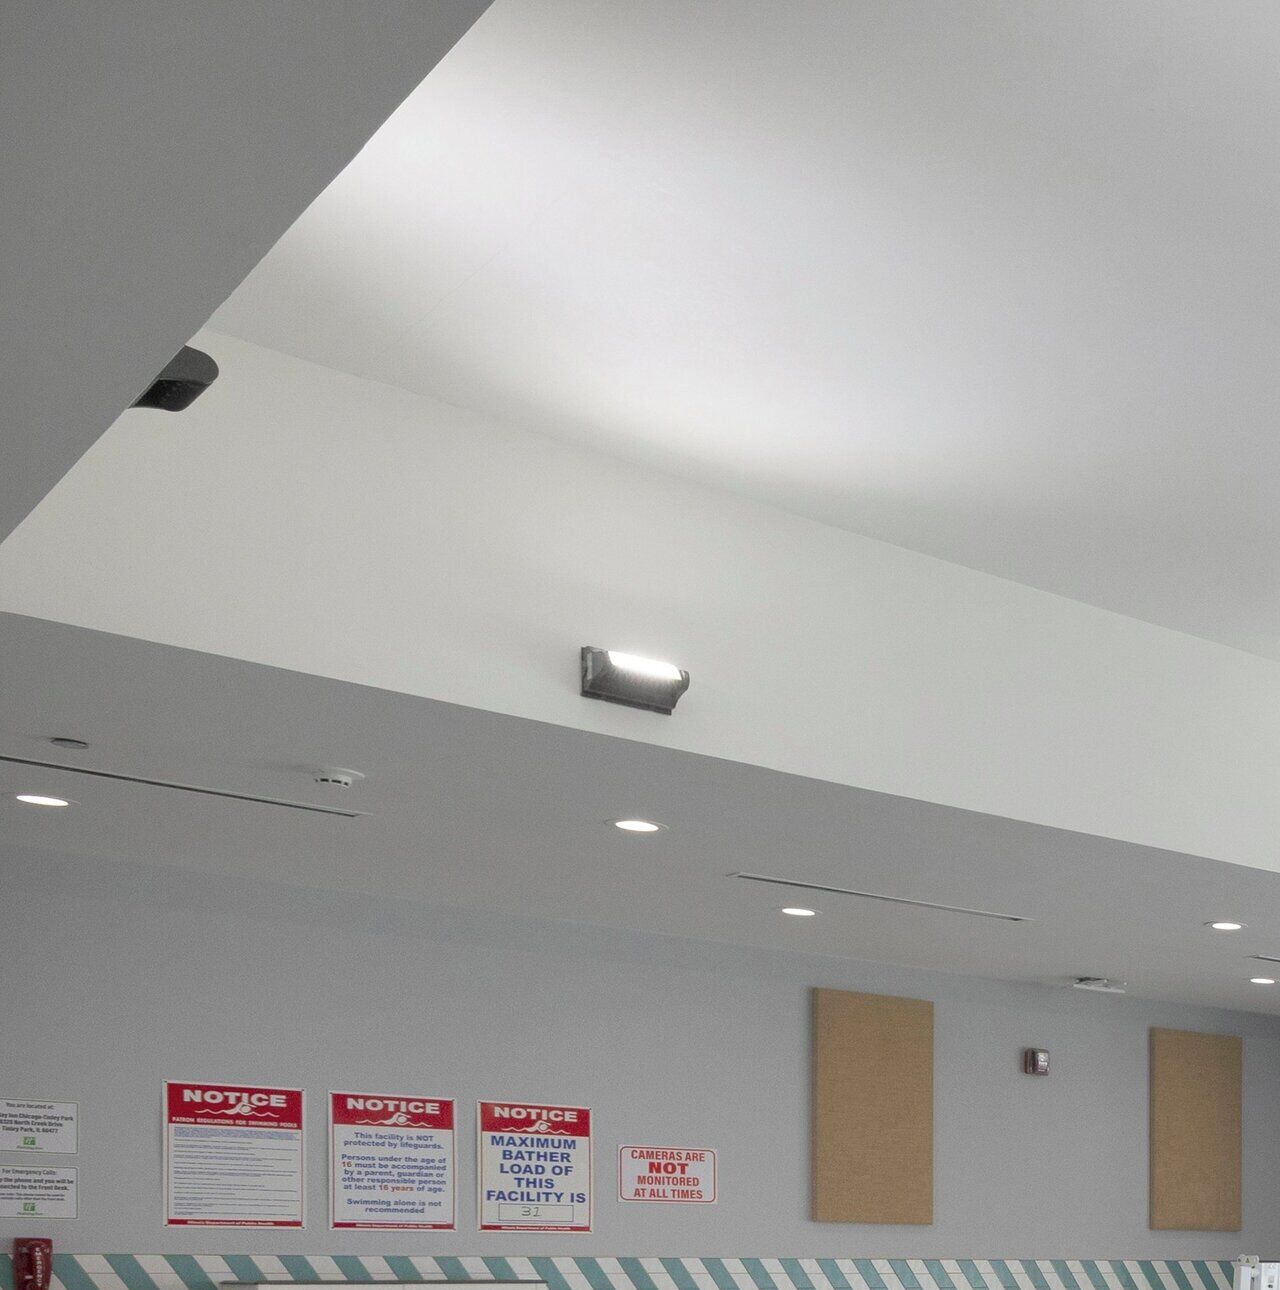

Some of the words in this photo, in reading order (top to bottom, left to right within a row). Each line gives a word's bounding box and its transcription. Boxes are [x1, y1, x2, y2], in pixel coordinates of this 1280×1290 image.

[183, 1089, 287, 1107] NOTICE
[347, 1098, 440, 1114] NOTICE
[494, 1106, 578, 1122] NOTICE
[375, 1133, 403, 1141] facility
[491, 1135, 576, 1149] MAXIMUM
[388, 1141, 397, 1149] by
[502, 1150, 571, 1162] BATHER
[631, 1149, 682, 1161] CAMERAS
[685, 1152, 705, 1162] ARE
[391, 1163, 446, 1171] accompanied
[500, 1163, 545, 1175] LOAD
[552, 1165, 574, 1176] OF
[649, 1162, 689, 1175] NOT
[397, 1170, 433, 1178] guardian
[367, 1177, 415, 1185] responsible
[514, 1177, 555, 1189] THIS
[637, 1176, 699, 1187] MONITORED
[487, 1190, 564, 1203] FACILITY
[570, 1193, 586, 1203] IS
[634, 1188, 647, 1198] AT
[649, 1188, 668, 1198] ALL
[670, 1189, 703, 1199] TIMES
[347, 1198, 391, 1206] Swimming
